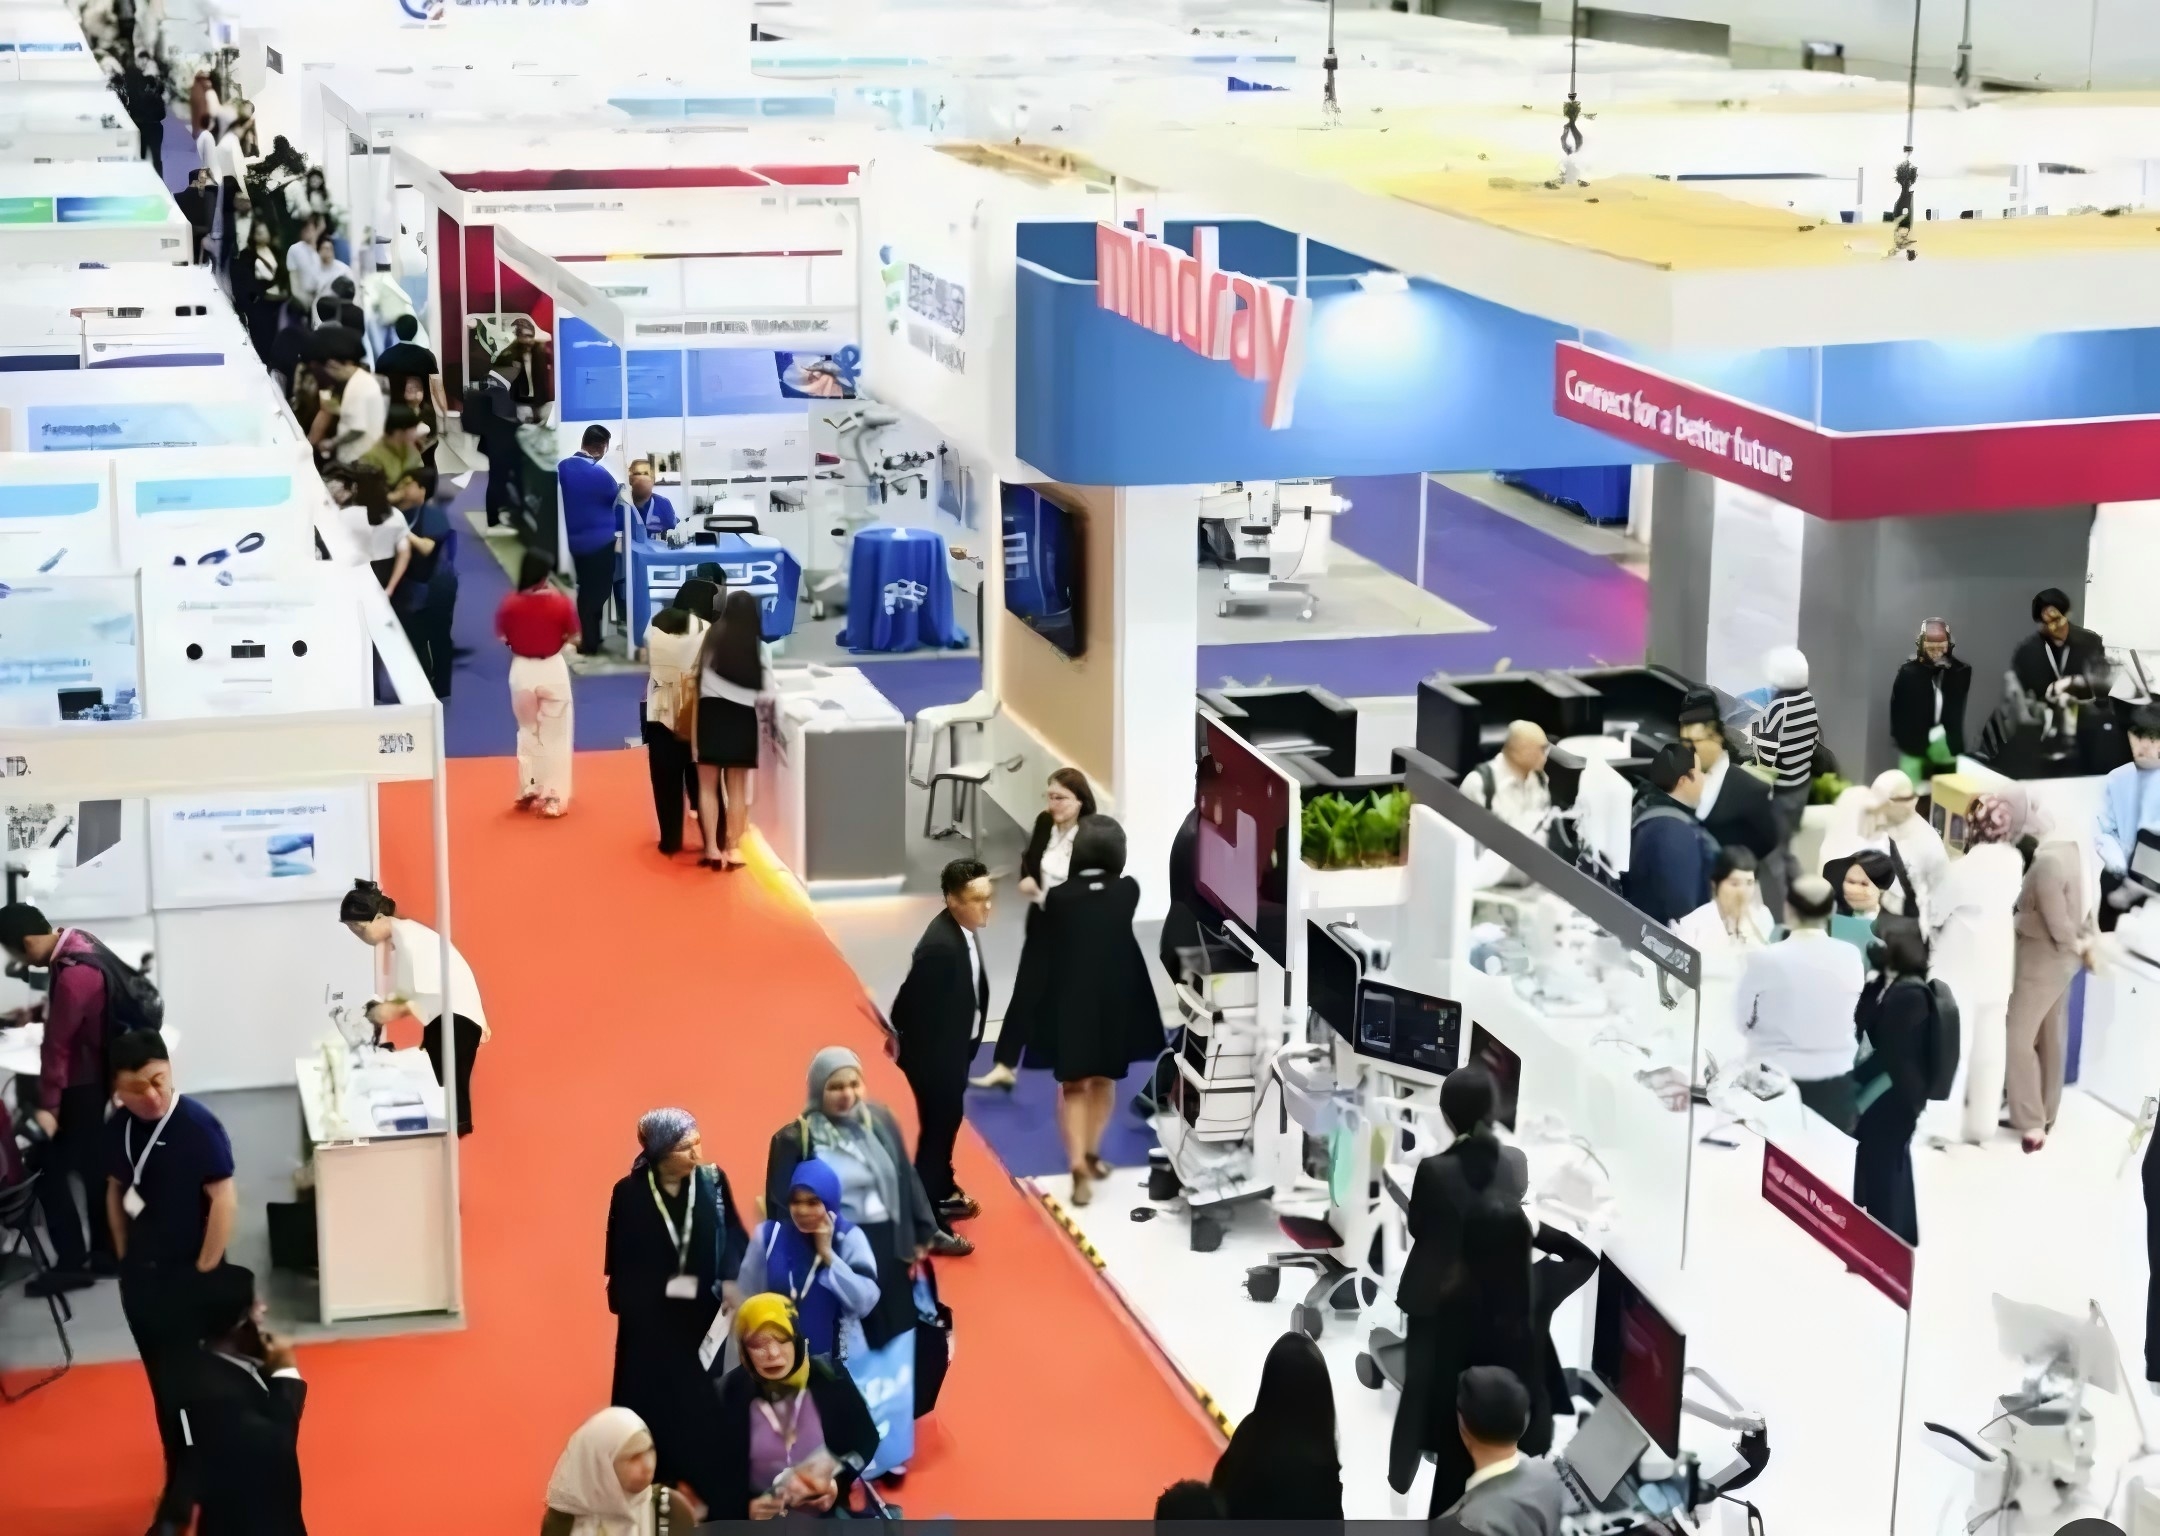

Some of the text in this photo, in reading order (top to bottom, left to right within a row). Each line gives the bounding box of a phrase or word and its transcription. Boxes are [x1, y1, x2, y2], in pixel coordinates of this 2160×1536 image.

[1096, 208, 1308, 430] mindray
[1565, 369, 1794, 483] Connect for a better future
